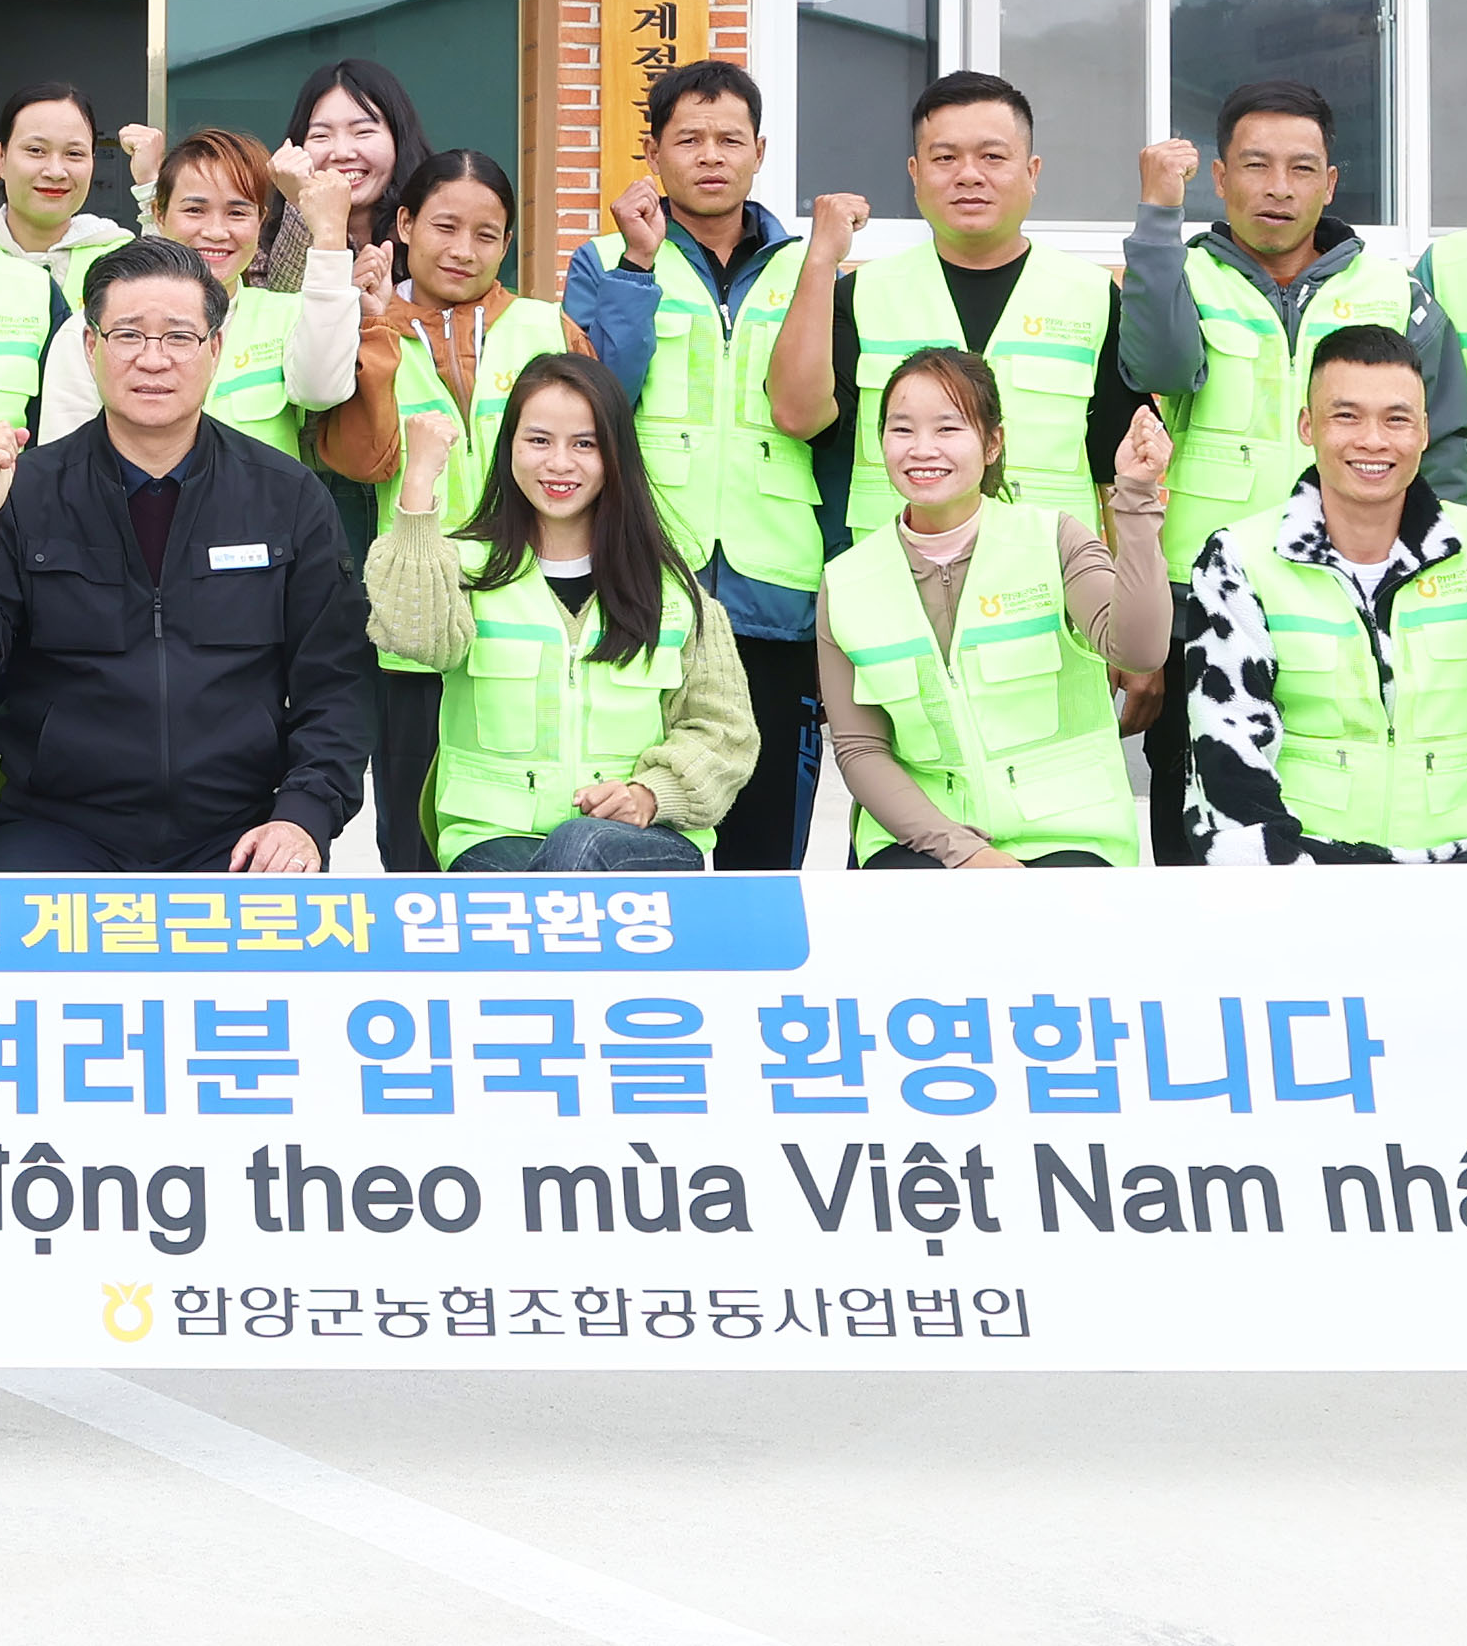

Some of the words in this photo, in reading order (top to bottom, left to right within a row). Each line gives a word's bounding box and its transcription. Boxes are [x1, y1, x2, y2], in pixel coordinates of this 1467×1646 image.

[21, 893, 376, 953] 계절근로자
[394, 890, 673, 954] 입국환영
[348, 999, 712, 1116] 입국을
[759, 995, 1384, 1115] 환영합니다
[246, 1145, 480, 1233] theo
[523, 1143, 753, 1233] mùa
[781, 1143, 1001, 1256] Việt
[1034, 1144, 1283, 1233] Nam
[171, 1285, 1031, 1339] 함양군농협조합공동사업법인
